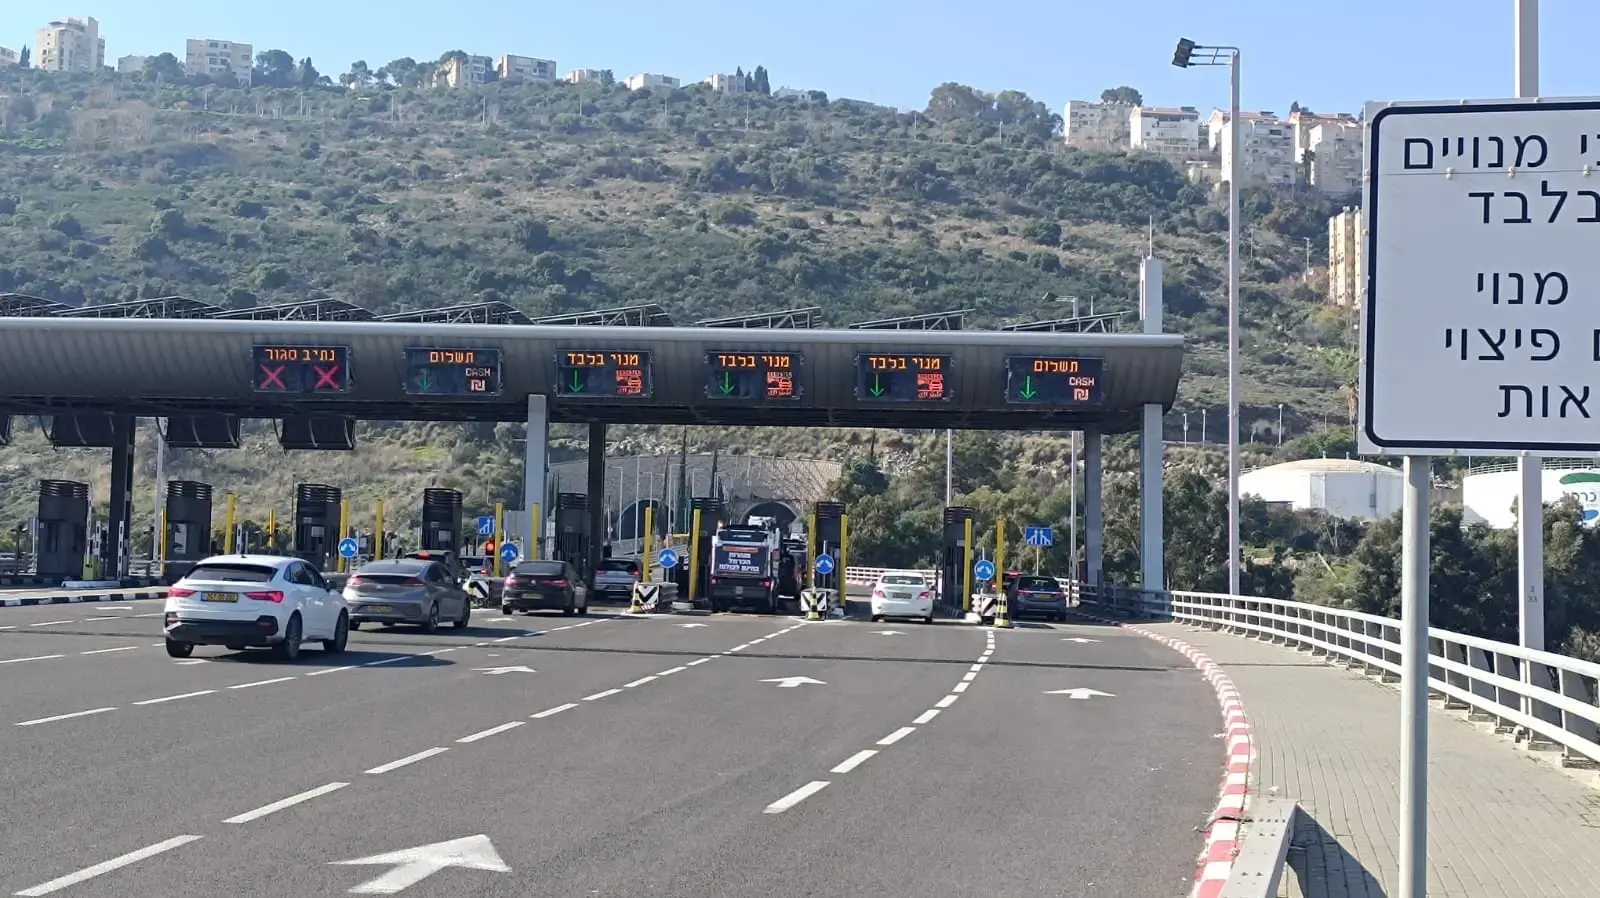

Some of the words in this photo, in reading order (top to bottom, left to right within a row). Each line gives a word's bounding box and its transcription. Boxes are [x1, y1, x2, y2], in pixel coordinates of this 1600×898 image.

[1404, 135, 1548, 170] מנויים
[1468, 181, 1600, 224] בלבד
[1477, 272, 1568, 305] מנוי
[1446, 328, 1560, 361] פיצוי
[265, 349, 297, 361] סגור
[303, 349, 335, 361] נתיב
[430, 351, 474, 363] תשלום
[567, 353, 605, 365] בלבד
[610, 353, 639, 366] מנוי
[718, 355, 756, 367] בלבד
[761, 355, 790, 368] מנוי
[869, 357, 906, 369] בלבד
[912, 357, 940, 370] מנוי
[1034, 360, 1078, 372] תשלום
[465, 367, 491, 377] CASH
[1069, 376, 1095, 386] CASH
